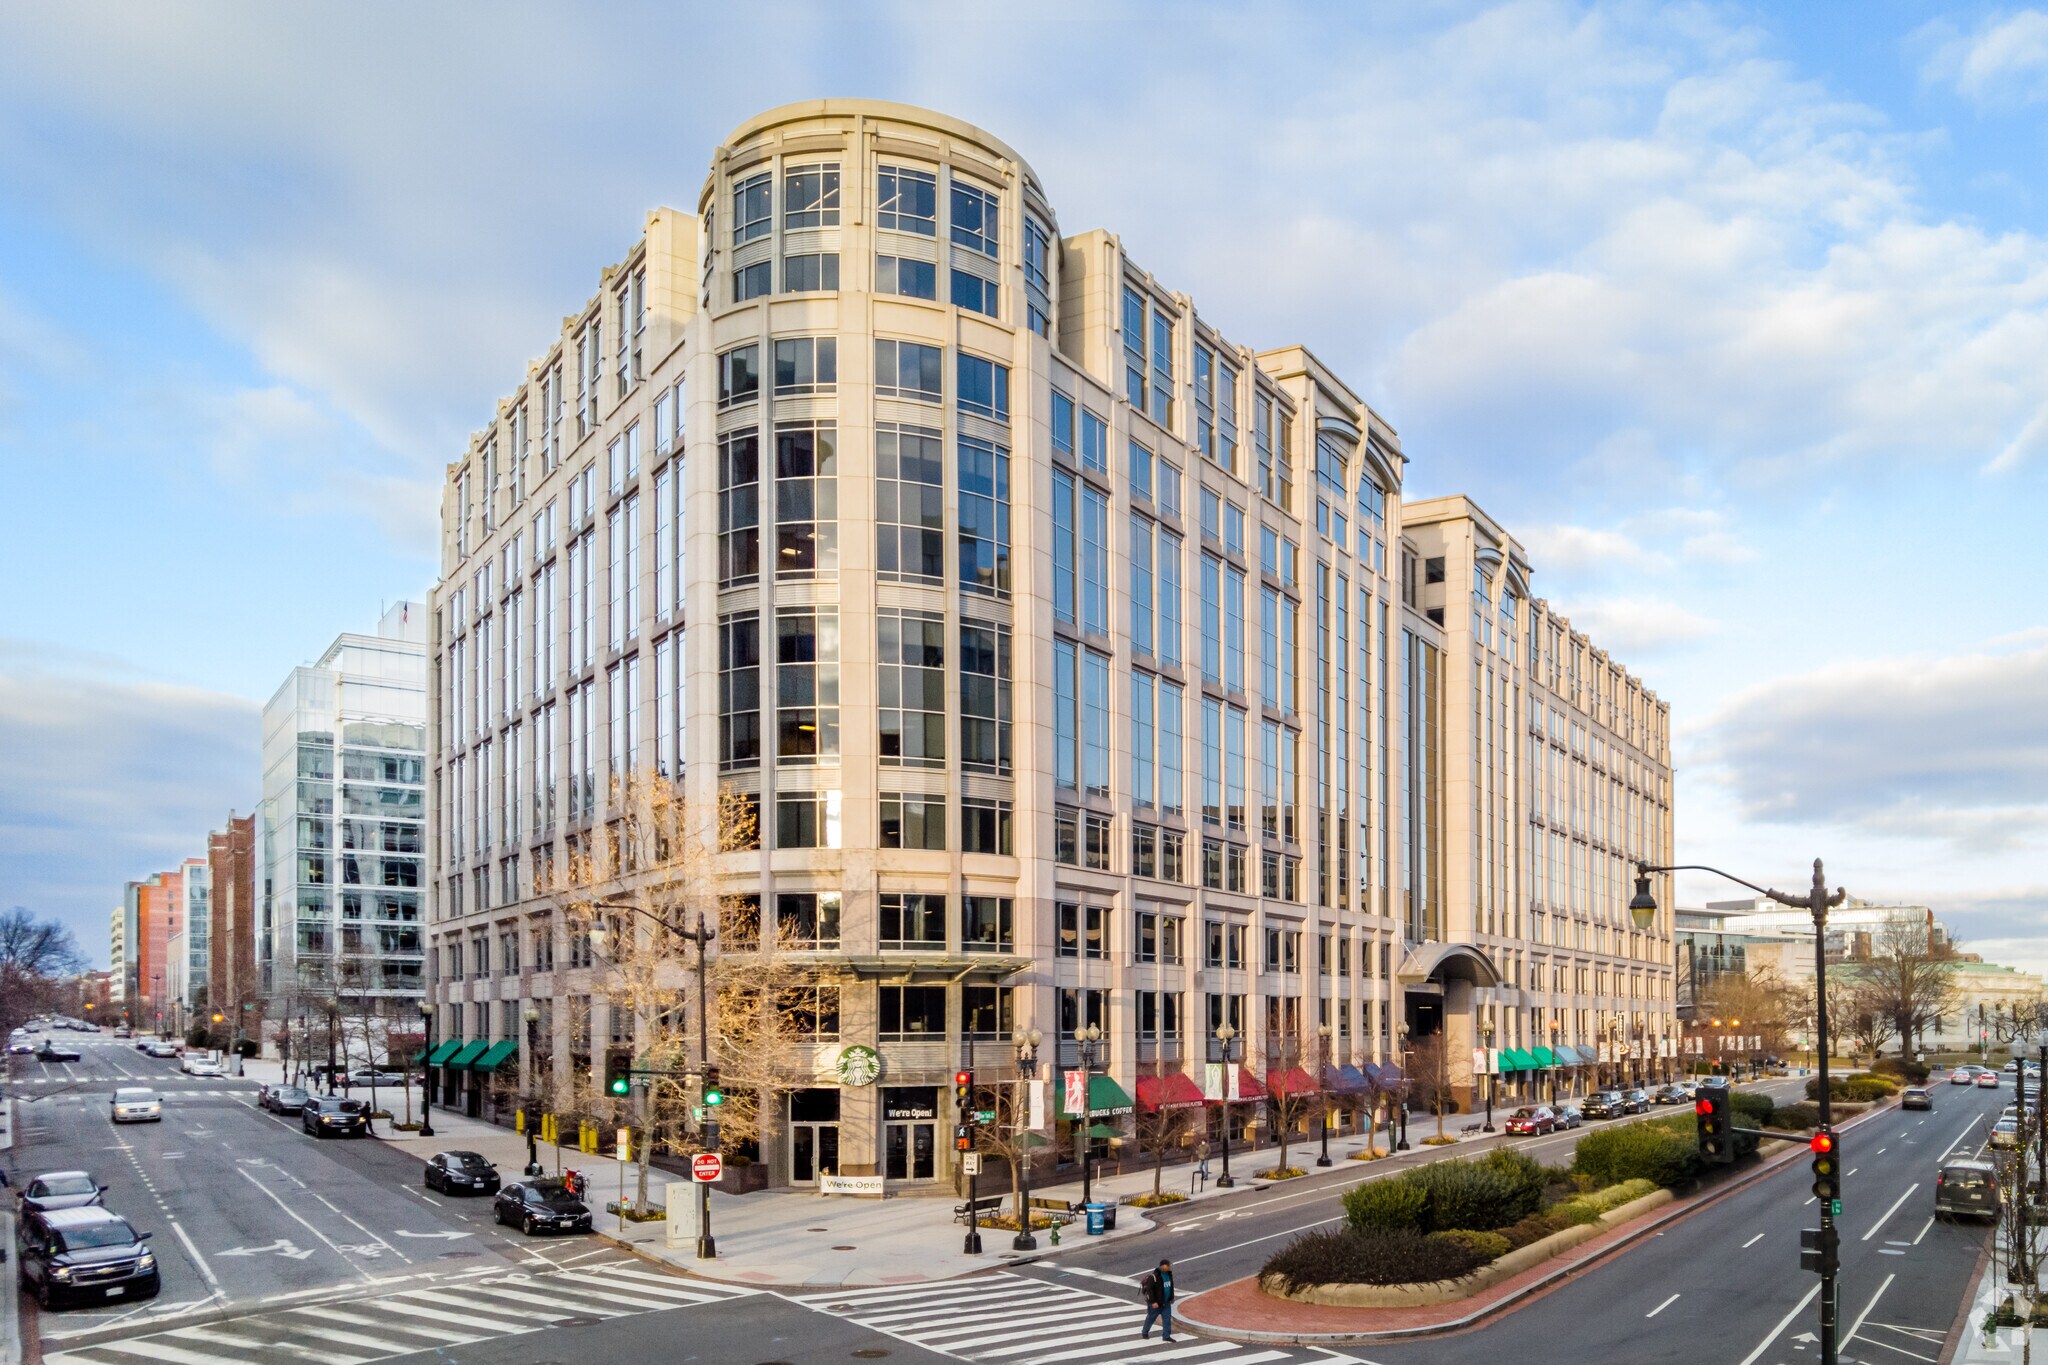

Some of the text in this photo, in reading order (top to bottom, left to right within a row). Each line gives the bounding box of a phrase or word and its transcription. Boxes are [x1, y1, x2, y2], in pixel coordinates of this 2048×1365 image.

[888, 1108, 933, 1119] We're Open!
[1112, 1106, 1133, 1115] COFFEE
[826, 1181, 882, 1190] We're Open
